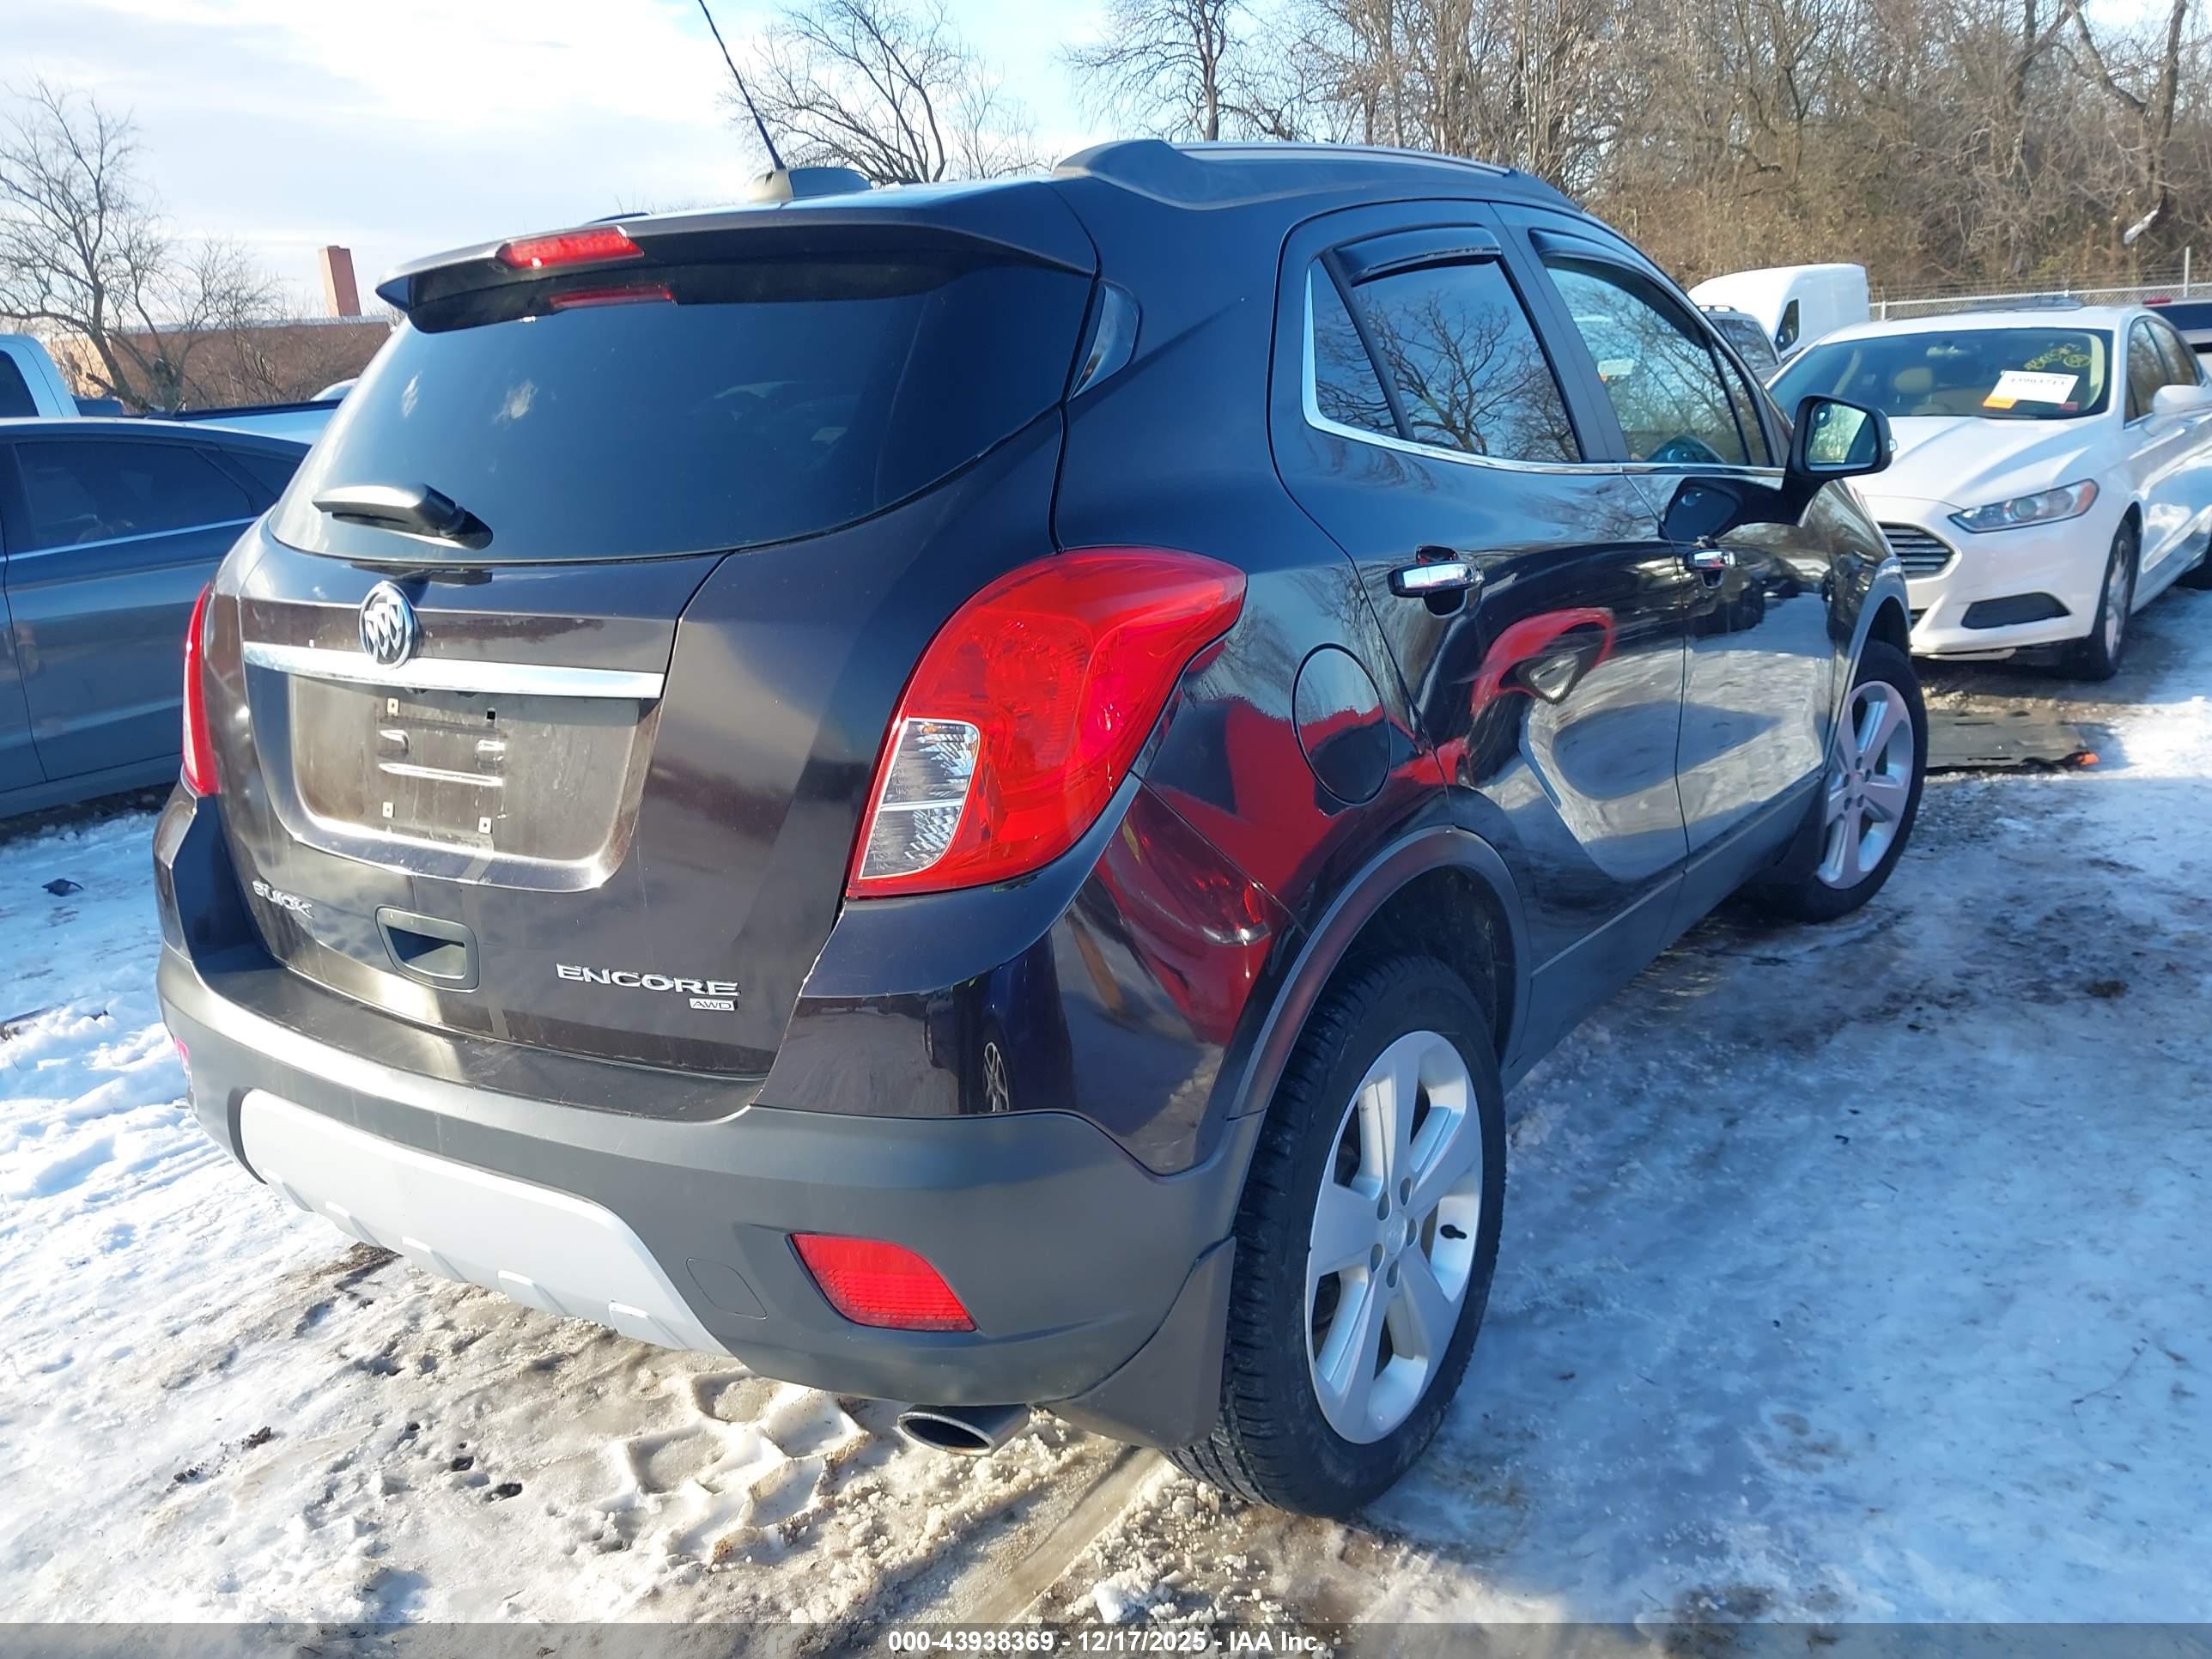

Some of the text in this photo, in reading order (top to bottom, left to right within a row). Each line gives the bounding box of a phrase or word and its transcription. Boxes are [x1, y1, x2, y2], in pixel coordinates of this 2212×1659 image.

[252, 879, 313, 919] BUICK
[556, 963, 741, 997] ENCORE
[690, 999, 735, 1011] AWD
